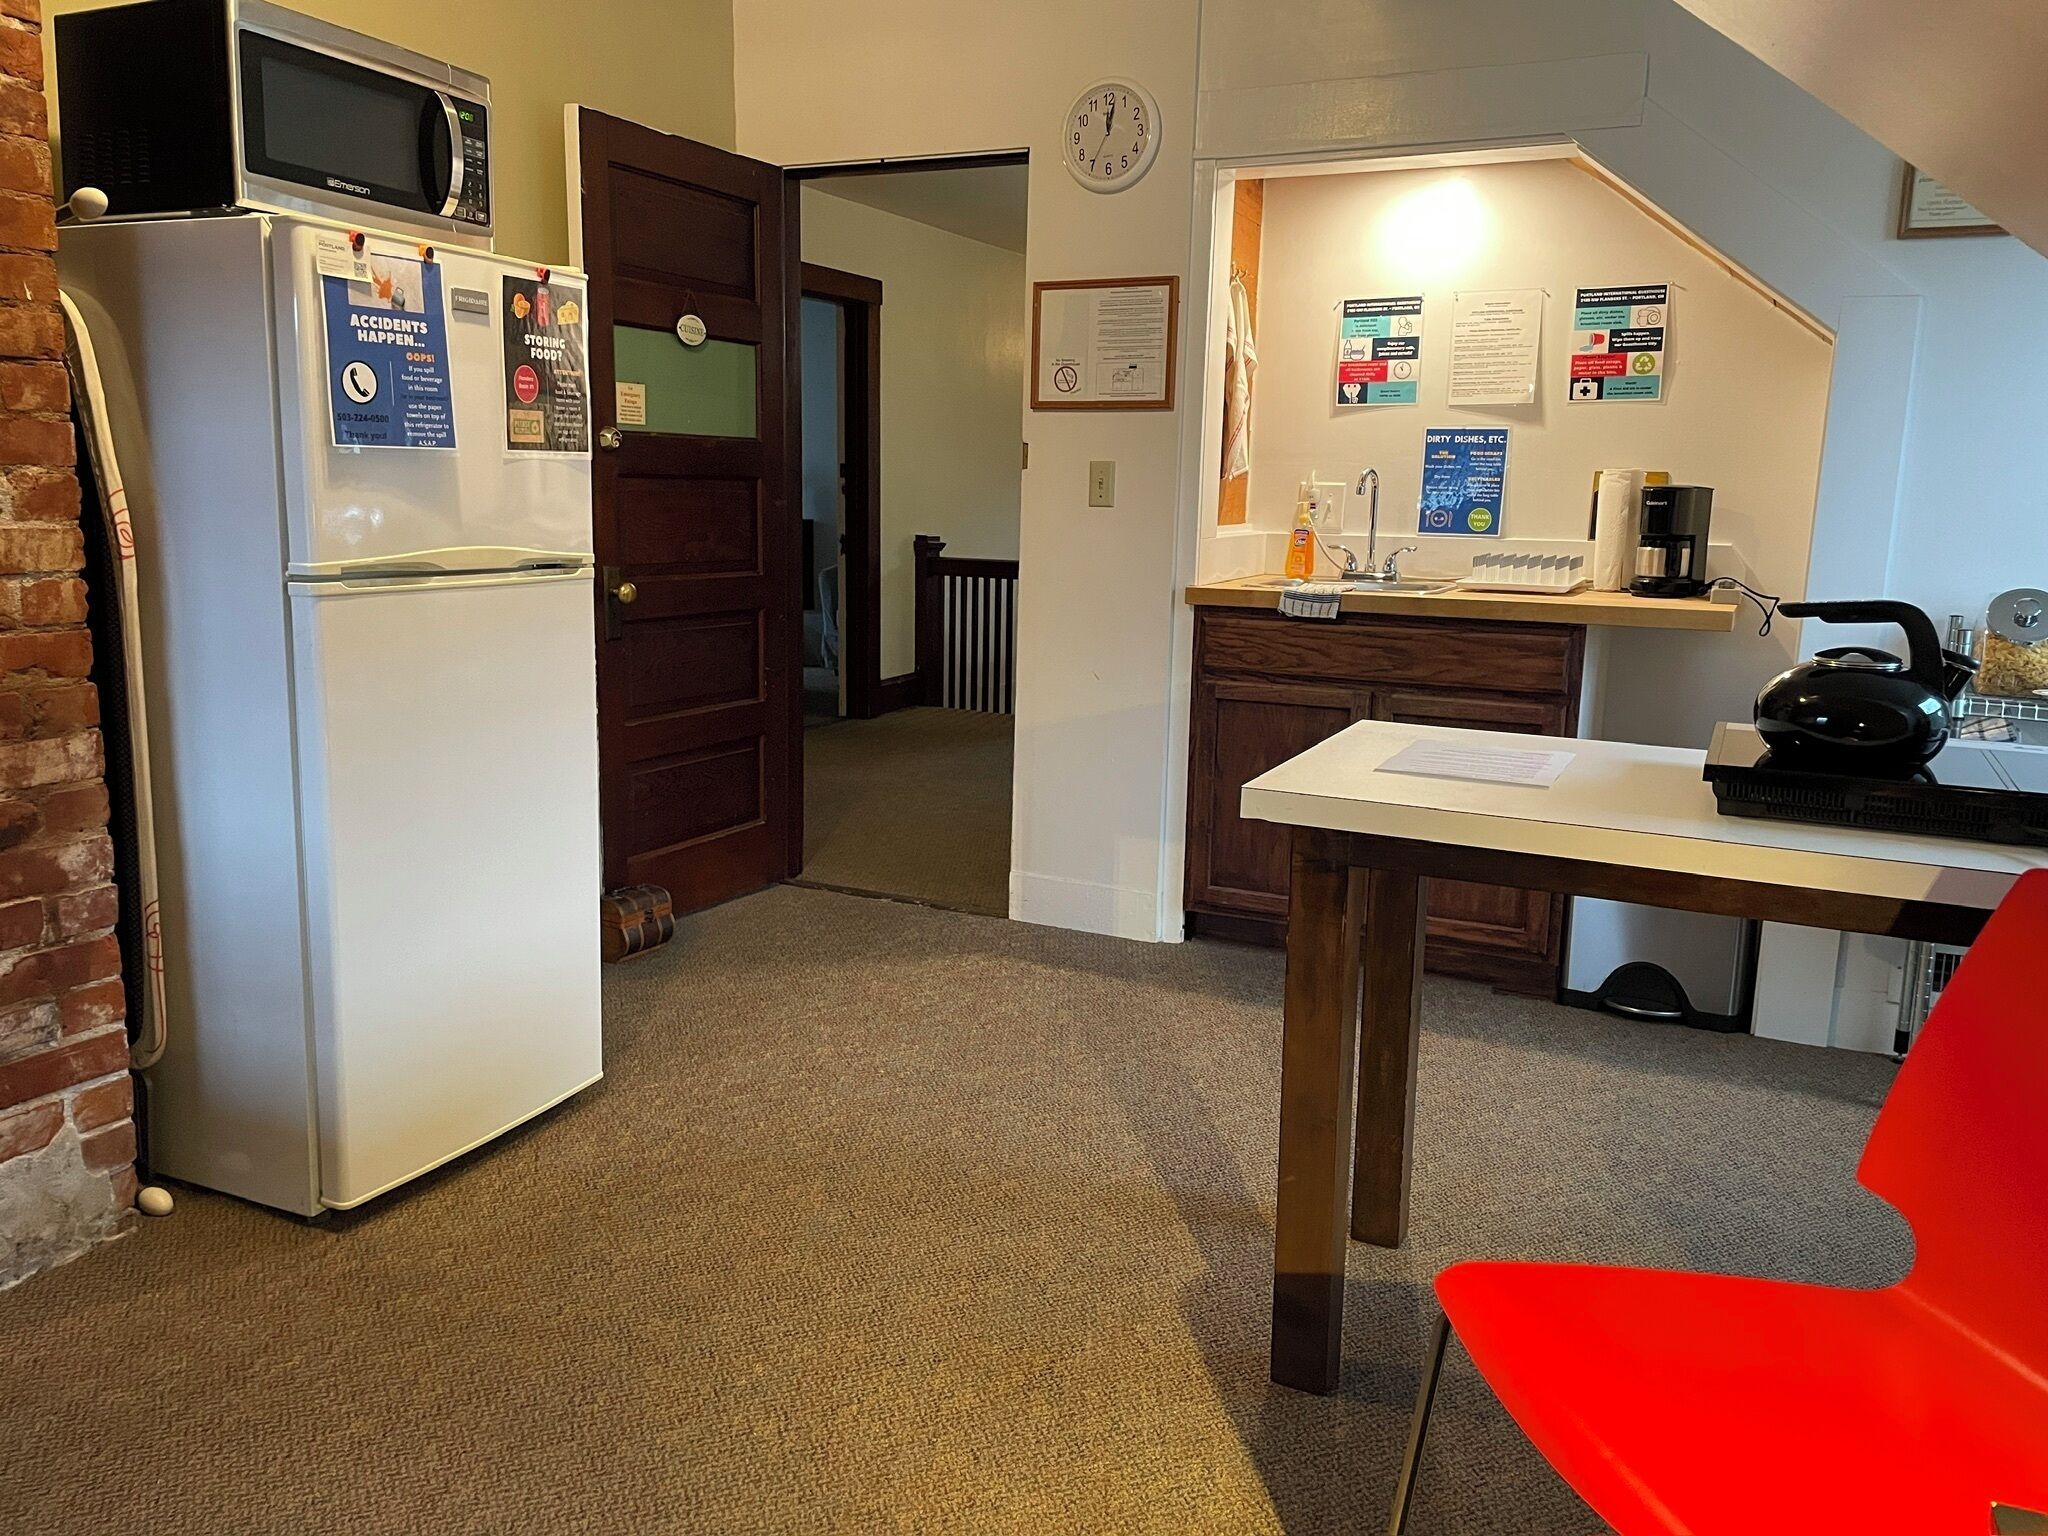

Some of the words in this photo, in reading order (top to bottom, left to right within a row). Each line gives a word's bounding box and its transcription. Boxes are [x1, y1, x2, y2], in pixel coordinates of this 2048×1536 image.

[1089, 99, 1098, 112] 11
[1103, 92, 1115, 106] 12
[1122, 95, 1127, 108] 1
[1133, 107, 1140, 120] 2
[1078, 114, 1088, 127] 10
[1137, 123, 1144, 137] 3
[1074, 132, 1080, 145] 9
[1132, 141, 1139, 154] 4
[1079, 148, 1085, 161] 8
[1089, 159, 1096, 172] 7
[1121, 154, 1128, 169] 5
[1105, 162, 1112, 176] 6
[335, 179, 370, 195] Emerson
[455, 295, 488, 307] FRIGIDAIRE
[350, 313, 428, 334] ACCIDENTS
[357, 329, 425, 347] HAPPEN...
[524, 333, 566, 349] STORING
[406, 352, 435, 363] OOPS!
[530, 347, 562, 361] FOOD?
[420, 376, 443, 384] beverage
[337, 412, 390, 423] 503-224-0500
[345, 430, 369, 439] Thank
[1427, 435, 1451, 443] DIRTY
[1454, 435, 1487, 444] DISHES,
[1488, 435, 1507, 443] ETC.
